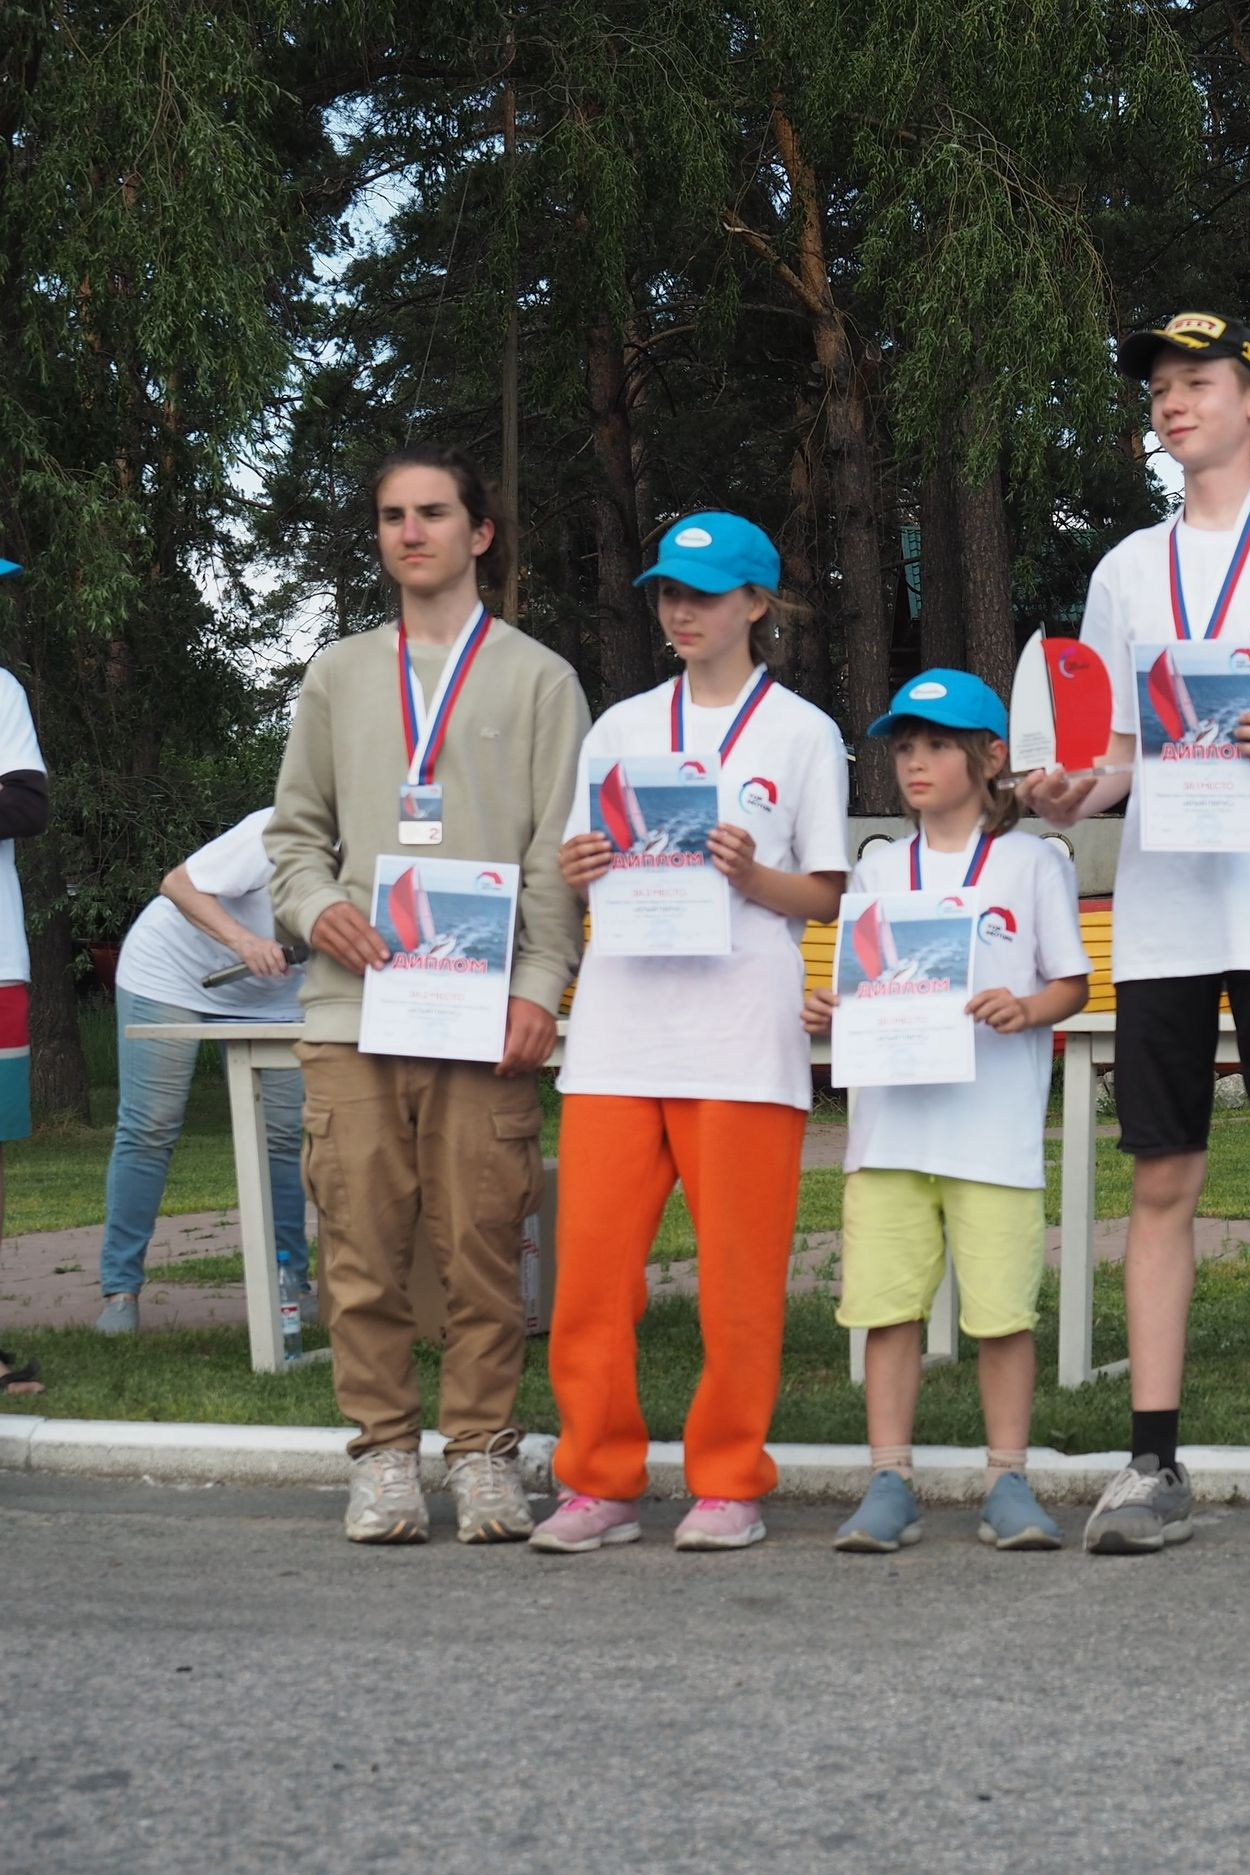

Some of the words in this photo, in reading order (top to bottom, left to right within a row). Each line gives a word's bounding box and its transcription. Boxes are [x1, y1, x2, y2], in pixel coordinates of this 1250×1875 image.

[429, 828, 439, 840] 2
[611, 853, 705, 869] ДИПЛОМ
[391, 952, 488, 974] ДИПЛОМ
[857, 978, 950, 999] ДИПЛОМ
